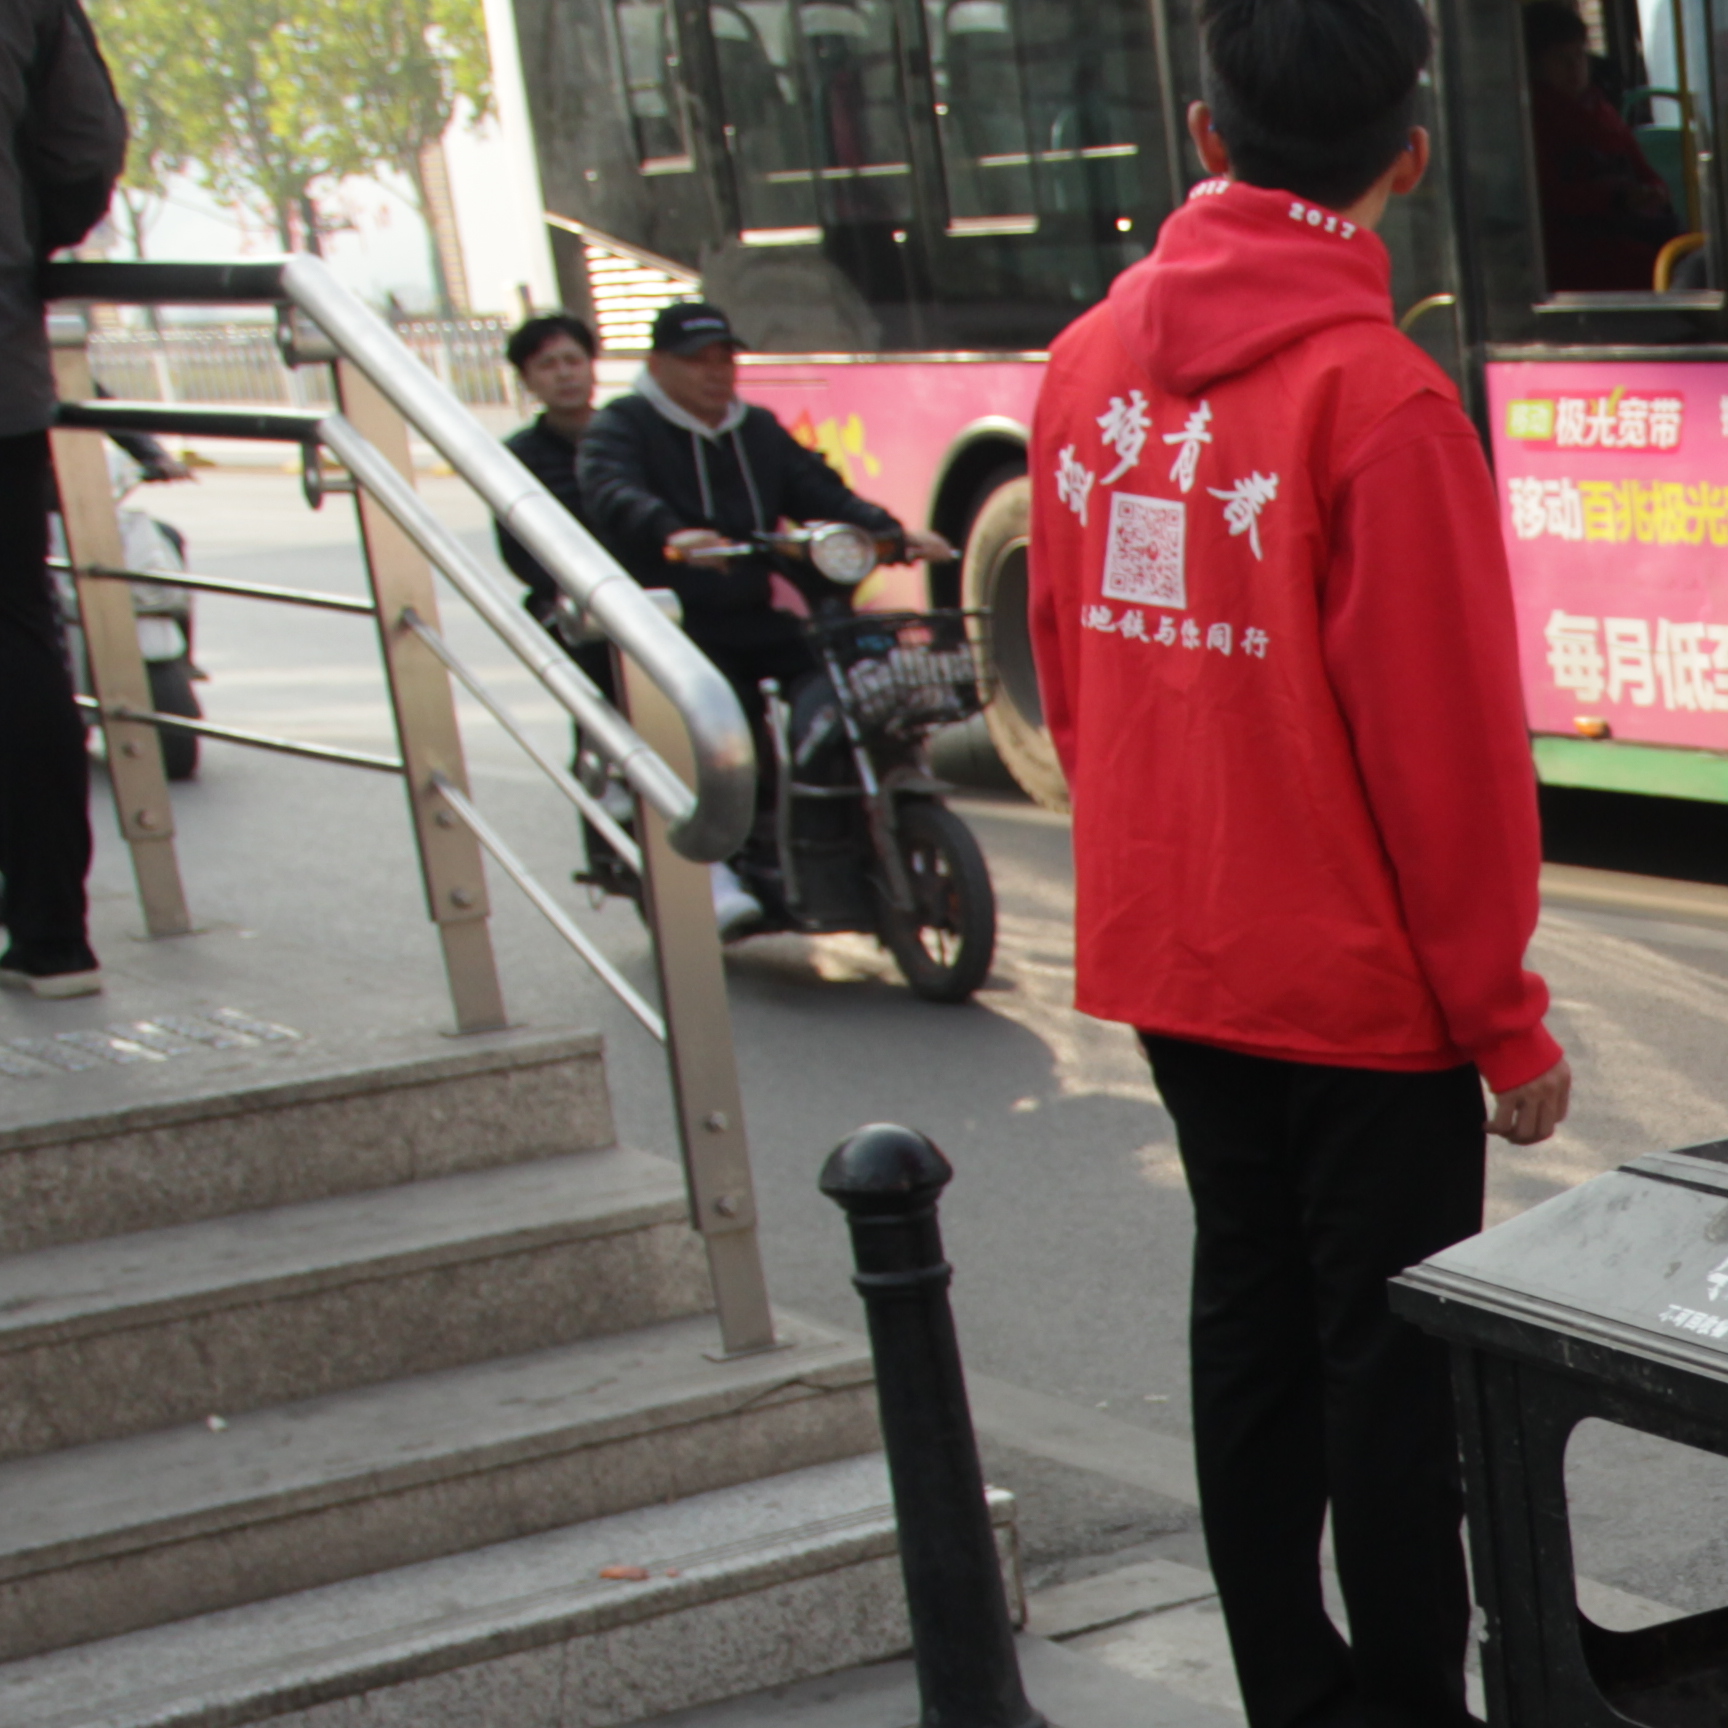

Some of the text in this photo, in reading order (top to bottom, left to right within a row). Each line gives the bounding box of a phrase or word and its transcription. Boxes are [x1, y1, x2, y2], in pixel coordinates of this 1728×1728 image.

[1288, 202, 1357, 240] 2017
[1555, 395, 1683, 450] 极光宽带
[1081, 603, 1271, 660] 地铁与你同行
